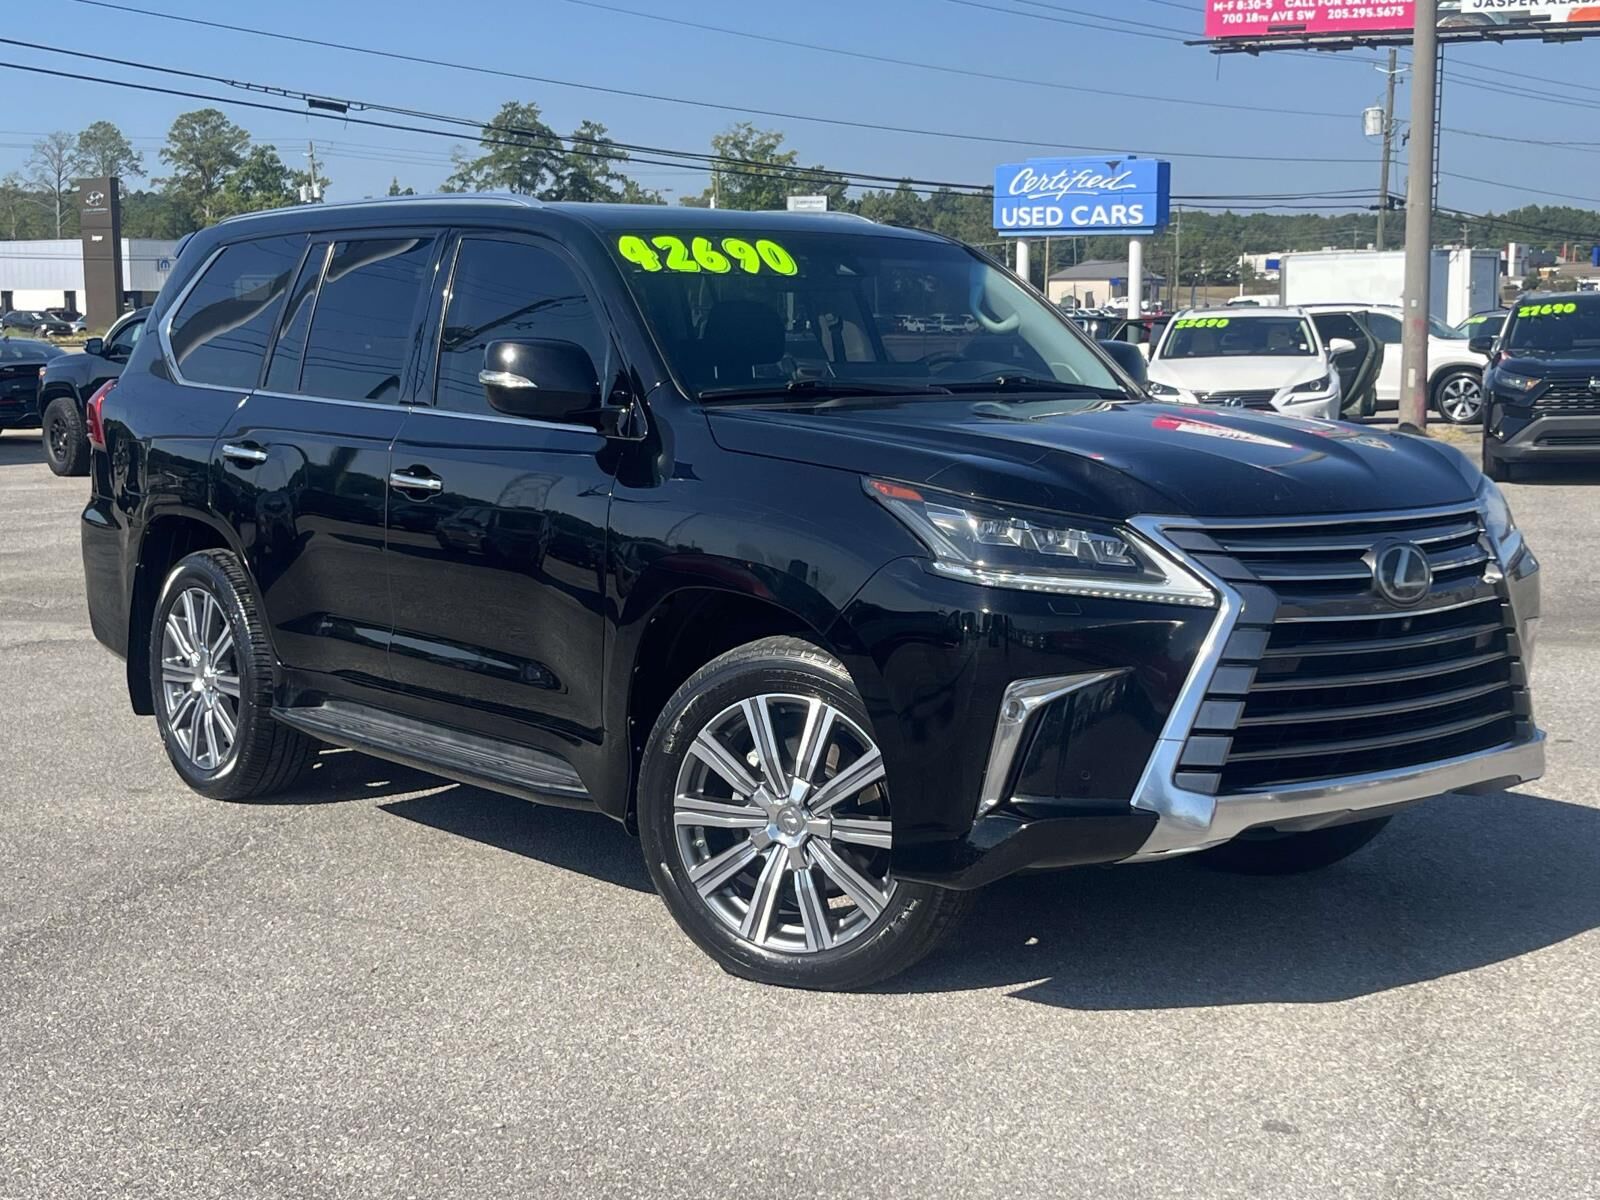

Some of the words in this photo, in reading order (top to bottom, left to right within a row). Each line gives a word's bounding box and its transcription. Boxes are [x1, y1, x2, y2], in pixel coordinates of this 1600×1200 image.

[1213, 1, 1234, 11] M-F
[1222, 13, 1243, 24] 700
[1271, 11, 1294, 21] AVE
[1296, 10, 1316, 20] SW
[1327, 6, 1404, 19] 205.295.5675
[1008, 167, 1137, 201] Certified
[1001, 205, 1064, 226] USED
[1070, 204, 1144, 225] CARS
[618, 235, 798, 275] 42690
